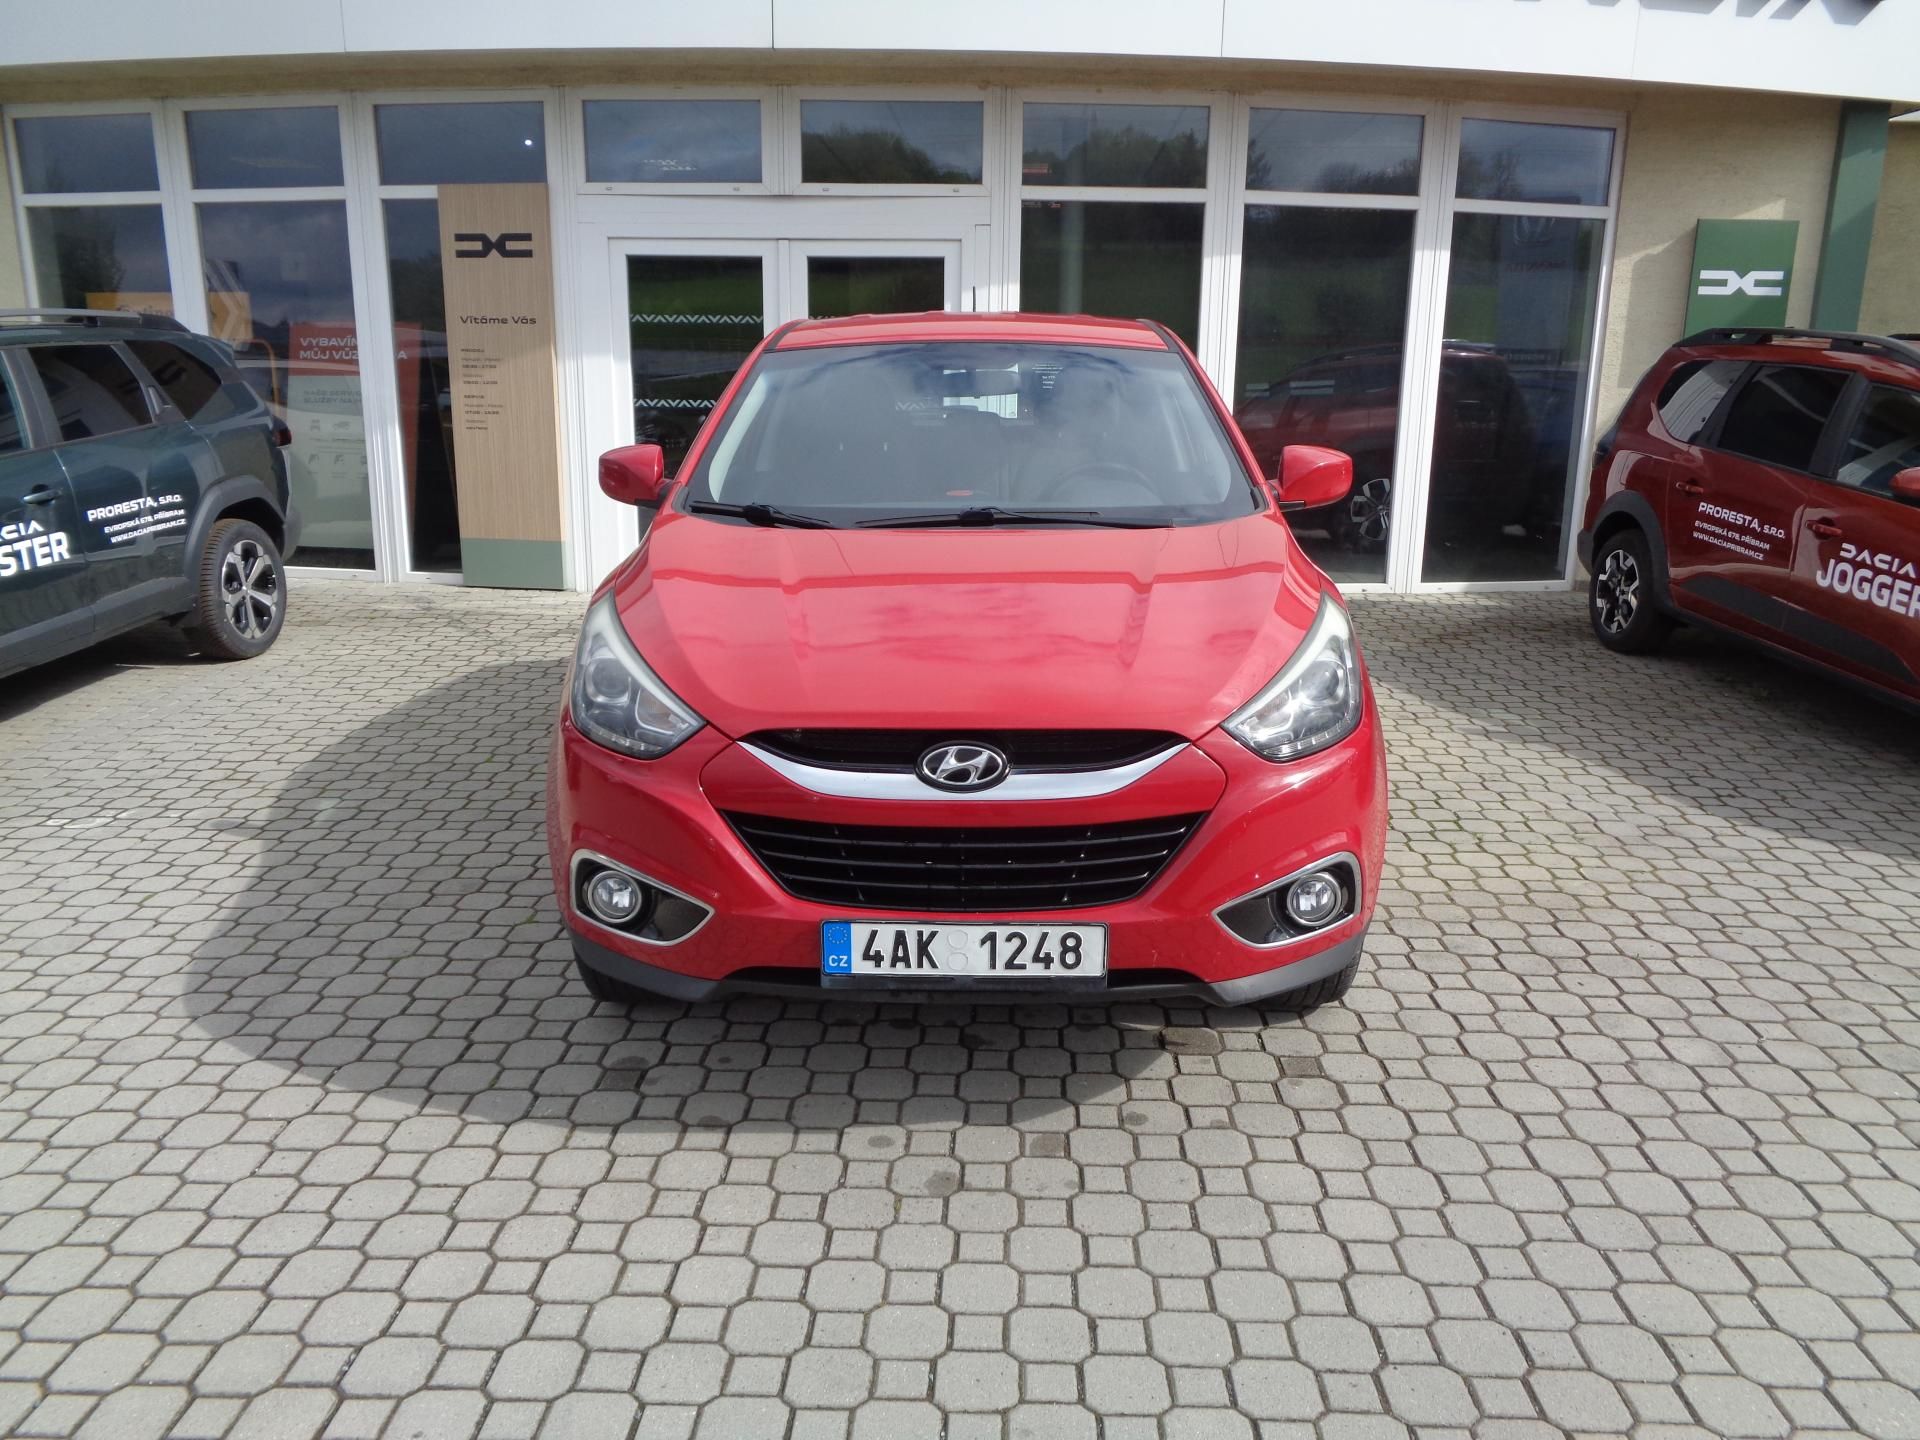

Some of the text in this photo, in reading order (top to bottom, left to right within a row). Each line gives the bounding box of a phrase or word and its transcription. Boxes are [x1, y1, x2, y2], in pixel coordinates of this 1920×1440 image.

[460, 315, 537, 325] Vítáme Vás
[87, 494, 183, 522] PRORESTA, S.R.O.
[1697, 502, 1786, 539] PRORESTA, S.R.O.
[0, 520, 45, 541] CIA
[104, 517, 140, 534] EVROPSKÁ
[1694, 520, 1728, 537] EVROPSKÁ
[1740, 535, 1770, 550] PŘÍBRAM
[1692, 531, 1764, 561] WWW.DACIAPRIBRAM.CZ
[1839, 542, 1917, 579] DACIA
[1815, 558, 1920, 618] JOGGER
[828, 954, 849, 968] CZ
[862, 929, 1083, 970] 4AK 1248
